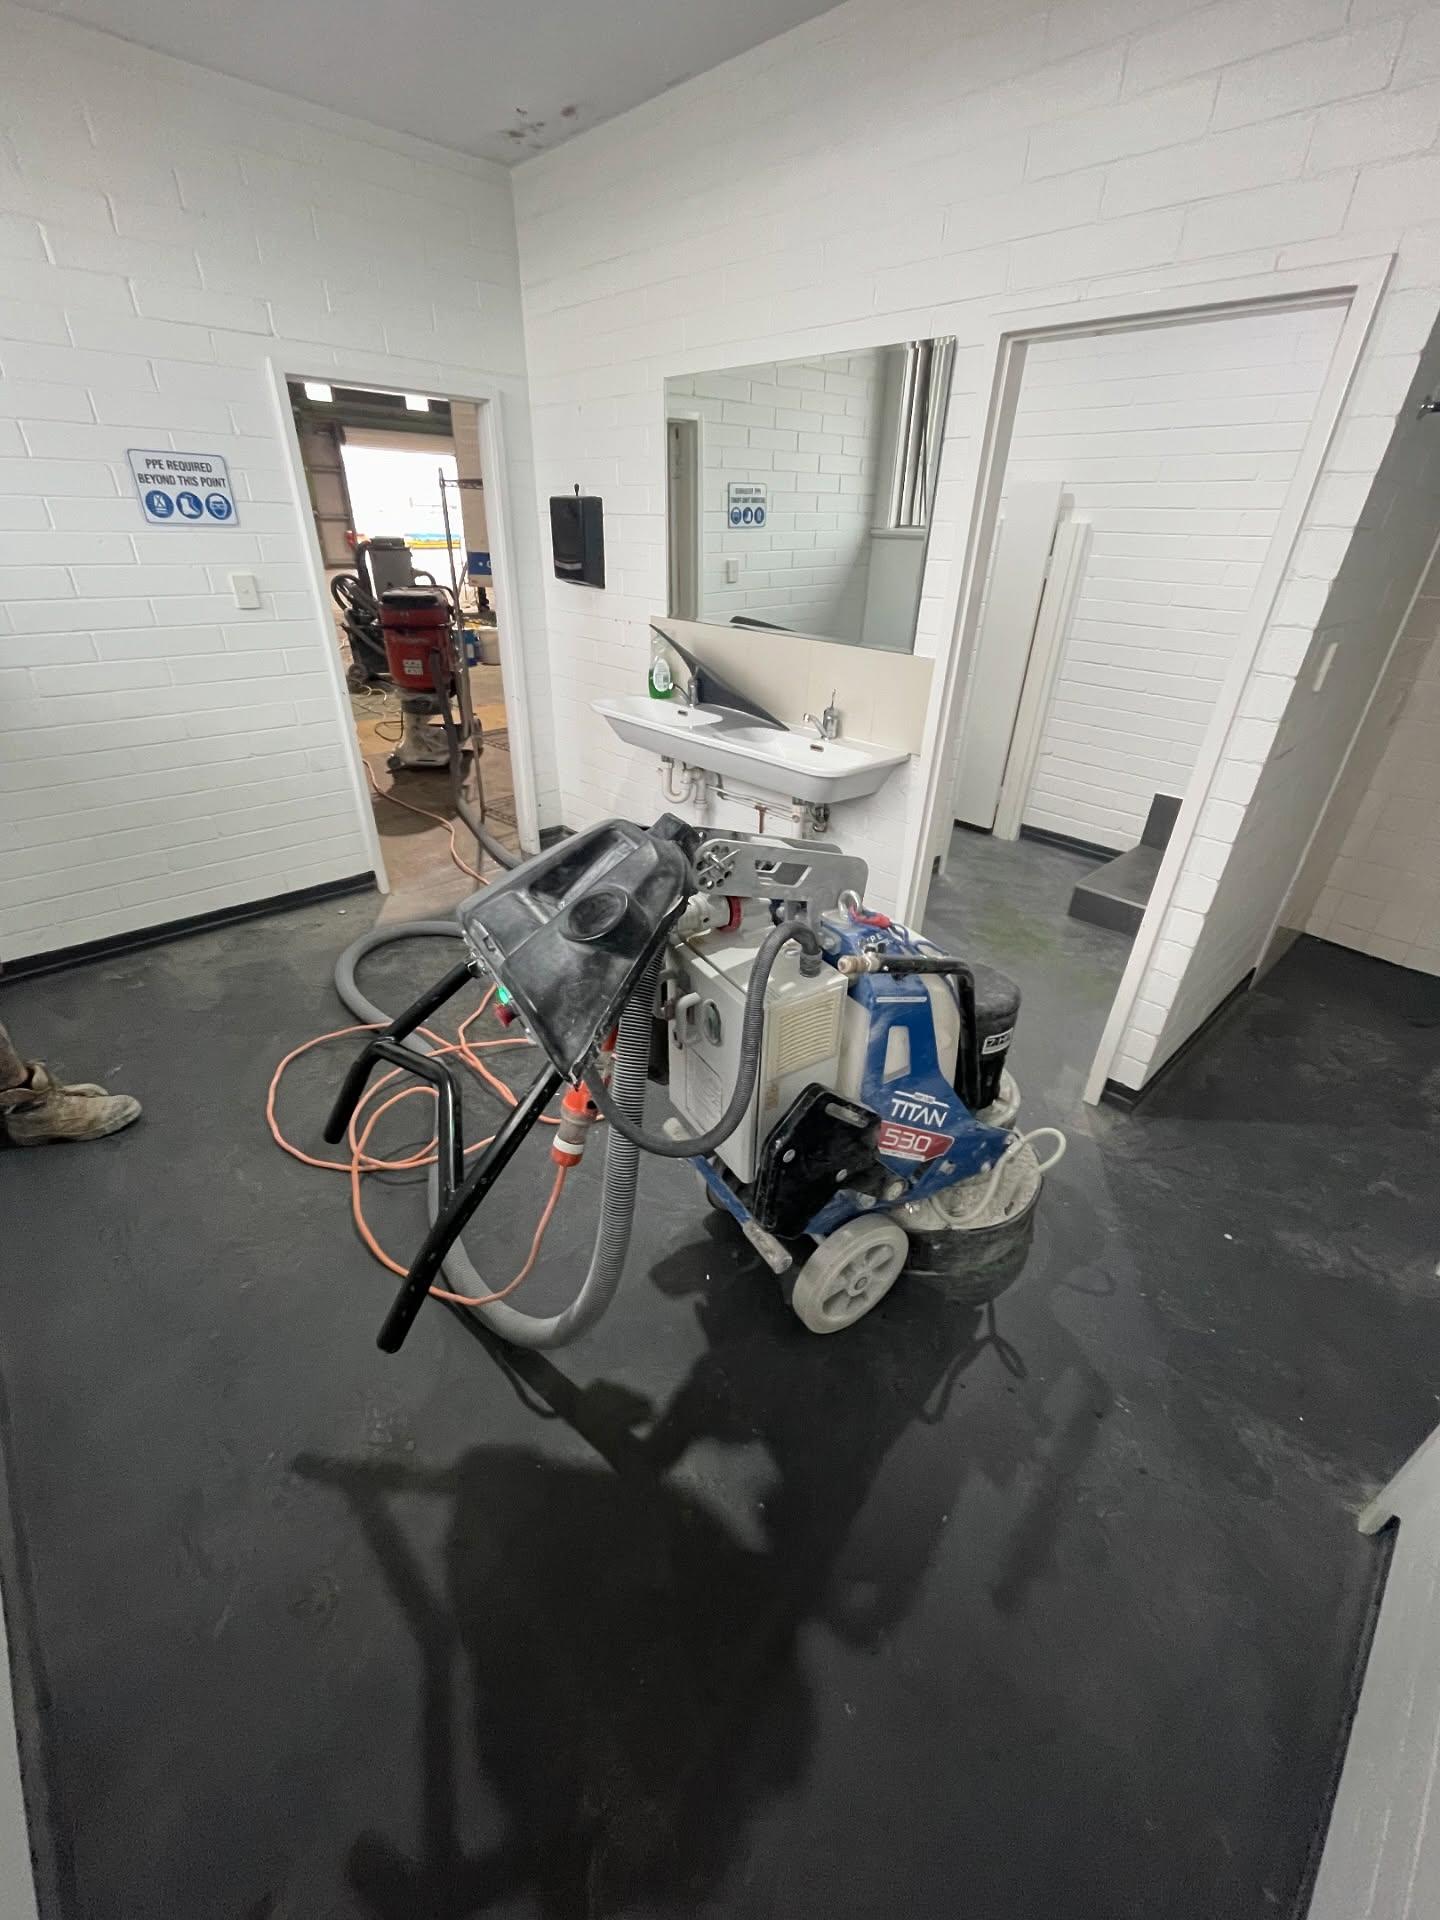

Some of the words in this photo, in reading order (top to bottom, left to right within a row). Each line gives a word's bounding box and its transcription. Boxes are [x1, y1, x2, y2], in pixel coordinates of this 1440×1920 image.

[145, 458, 164, 470] PPE
[166, 460, 213, 473] REQUIRED
[137, 473, 176, 486] BEYOND
[177, 475, 199, 487] THIS
[200, 477, 227, 488] POINT
[891, 1098, 948, 1128] TITAN
[881, 1128, 932, 1152] 530
